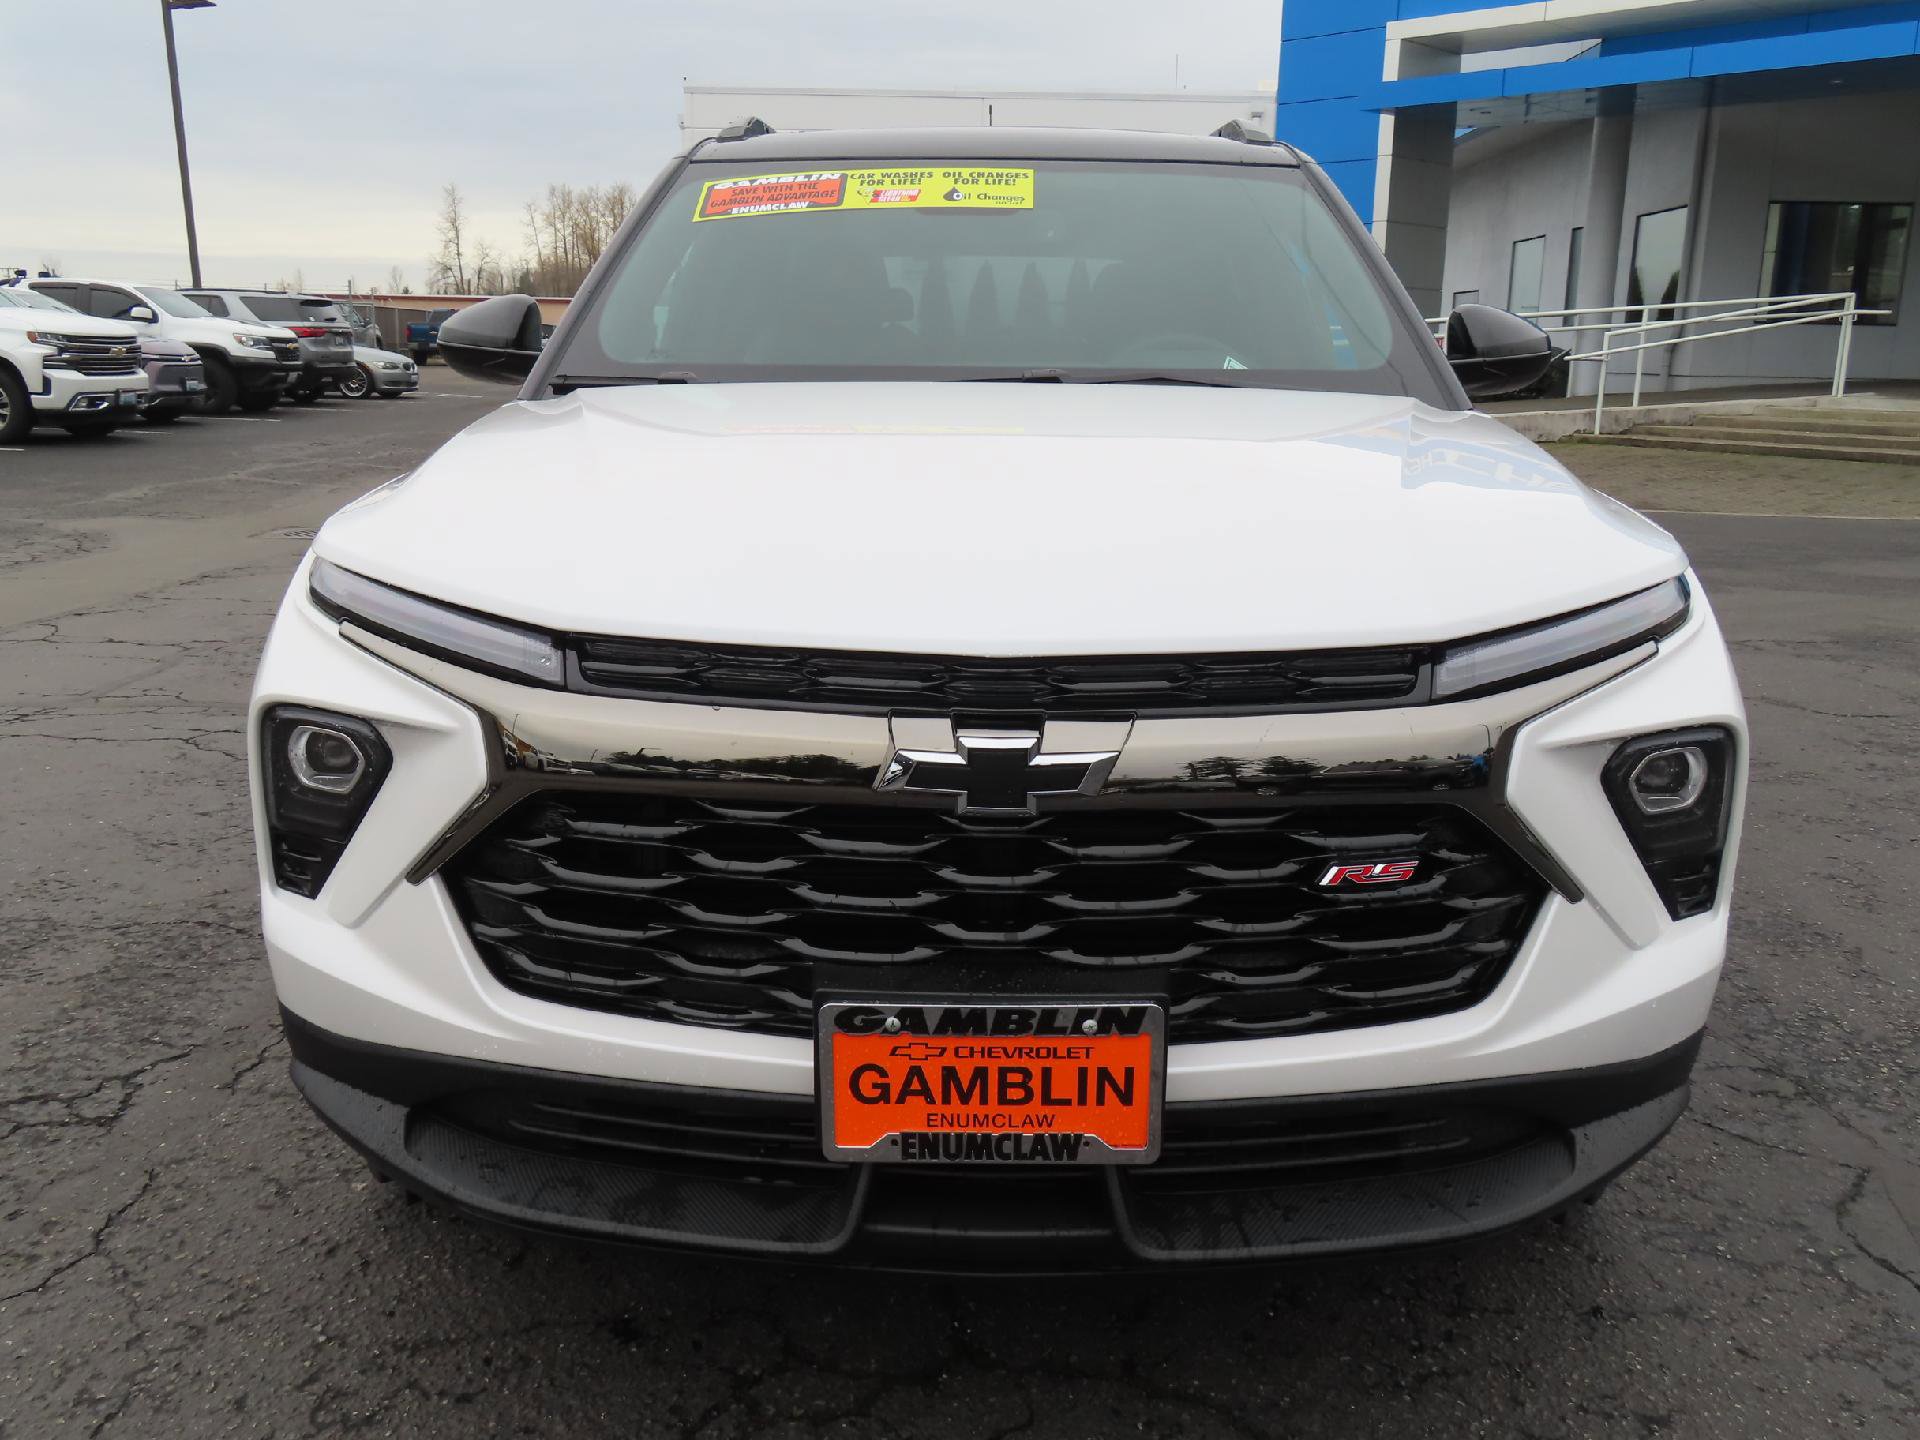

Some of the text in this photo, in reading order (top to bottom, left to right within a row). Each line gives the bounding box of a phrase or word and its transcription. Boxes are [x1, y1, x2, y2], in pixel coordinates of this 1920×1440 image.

[881, 171, 934, 179] WASHES
[890, 178, 922, 186] LIFE!
[968, 171, 1029, 179] CHANGES
[984, 178, 1017, 186] LIFE!
[732, 182, 818, 197] SAVE WITH THE
[711, 189, 836, 208] GAMBLIN ADVANTAGE
[731, 201, 809, 214] ENUMCLAW
[1319, 861, 1419, 885] RS
[833, 1006, 1149, 1036] GAMBLIN
[953, 1046, 1095, 1060] CHEVROLET
[849, 1063, 1136, 1107] GAMBLIN
[926, 1113, 1056, 1129] ENUMCLAW
[901, 1132, 1083, 1161] ENUMCLAW
